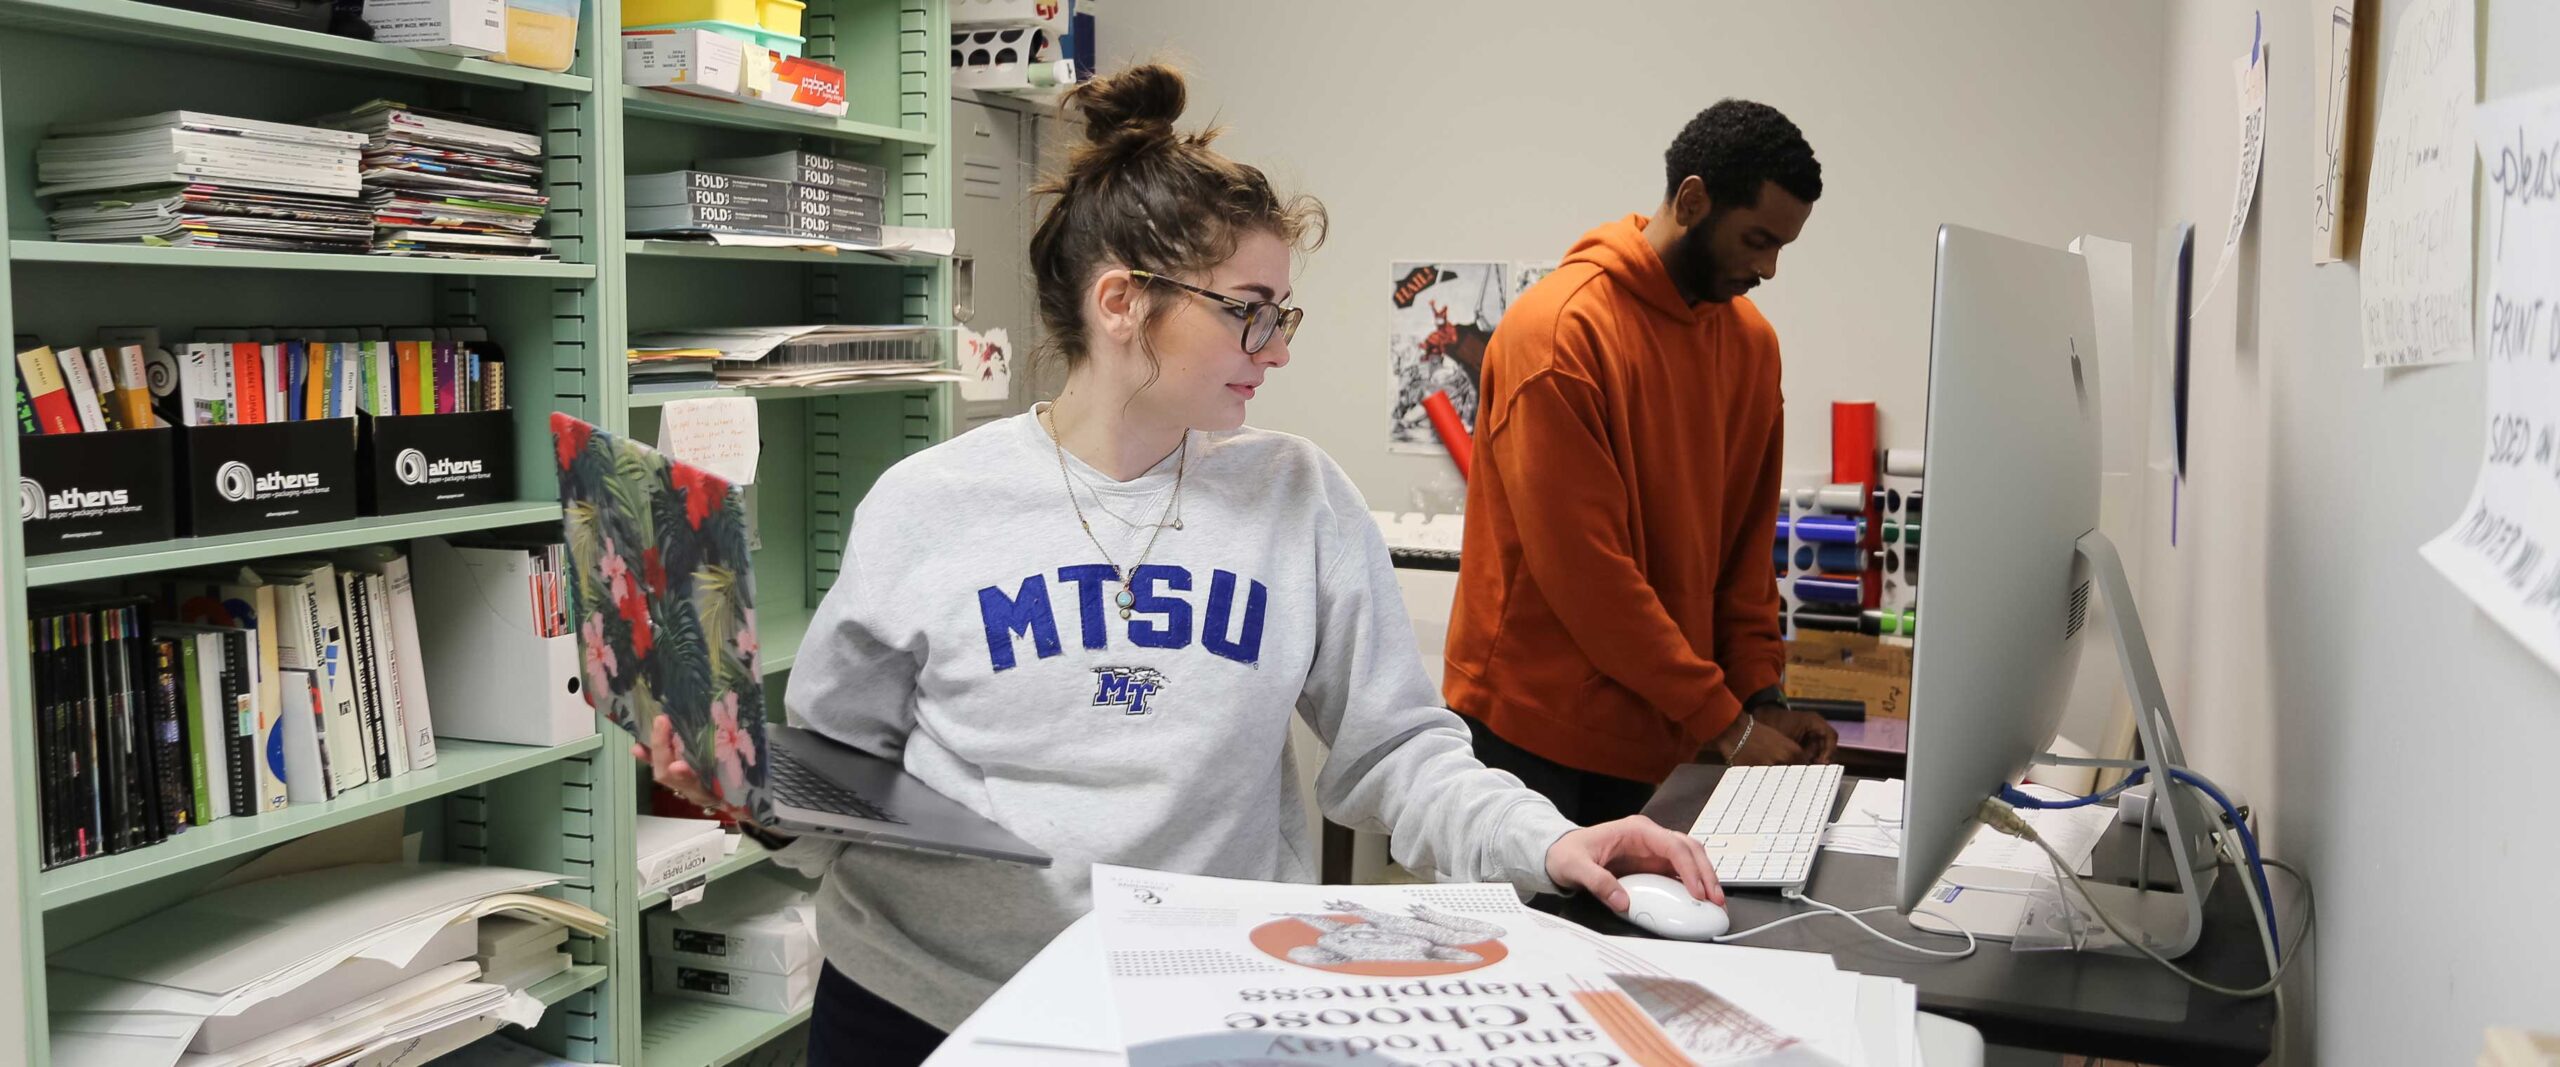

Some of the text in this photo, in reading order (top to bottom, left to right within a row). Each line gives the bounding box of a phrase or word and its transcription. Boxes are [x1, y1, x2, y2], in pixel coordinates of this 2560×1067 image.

[2492, 125, 2560, 262] pleas
[1395, 266, 1434, 304] HAIL!
[2490, 293, 2543, 361] PRINT
[429, 458, 482, 476] athens
[256, 471, 319, 492] athens
[49, 487, 129, 510] athens
[49, 510, 68, 520] paper
[72, 507, 104, 518] packaging
[122, 505, 142, 513] format
[978, 564, 1268, 672] MTSU
[1094, 670, 1156, 715] MT
[663, 857, 702, 880] COPY PAPER
[1239, 980, 1559, 1003] Happiness
[1224, 1003, 1583, 1031] I Choose
[1266, 1027, 1596, 1058] and Today
